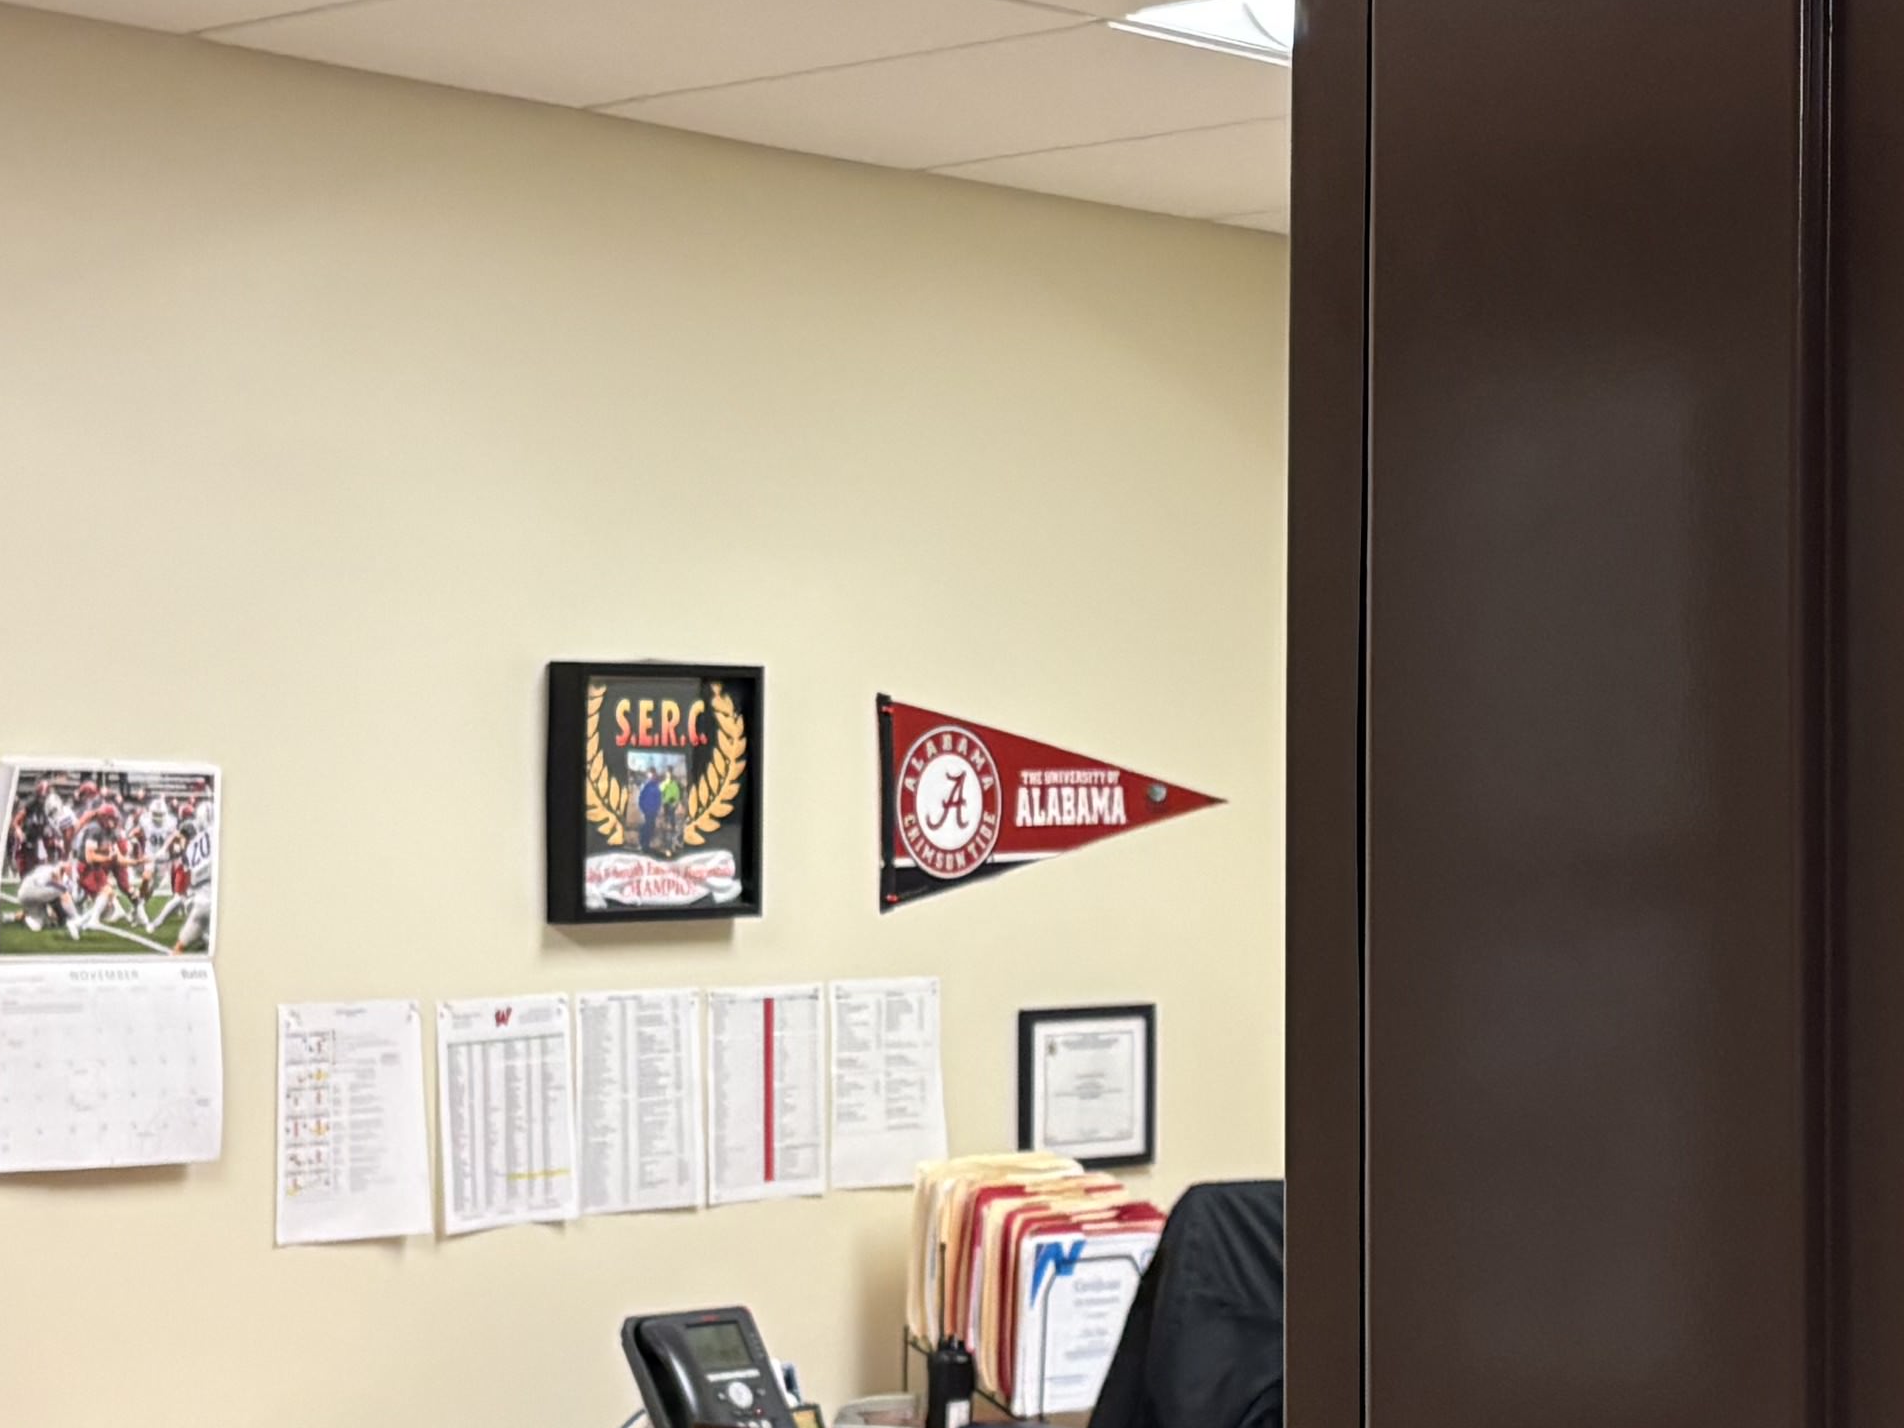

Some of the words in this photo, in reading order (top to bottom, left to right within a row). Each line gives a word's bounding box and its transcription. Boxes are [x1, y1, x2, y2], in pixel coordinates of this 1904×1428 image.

[615, 698, 709, 748] S.E.R.C.
[904, 733, 994, 794] ALABAMA
[1021, 770, 1042, 786] THE
[1043, 770, 1107, 786] UNIVERSITY
[1107, 769, 1121, 785] OF
[925, 769, 969, 832] A
[1015, 786, 1127, 827] ALABAMA
[905, 812, 966, 871] CRIMSON
[967, 810, 996, 862] TIDE
[69, 969, 139, 982] NOVEMBER
